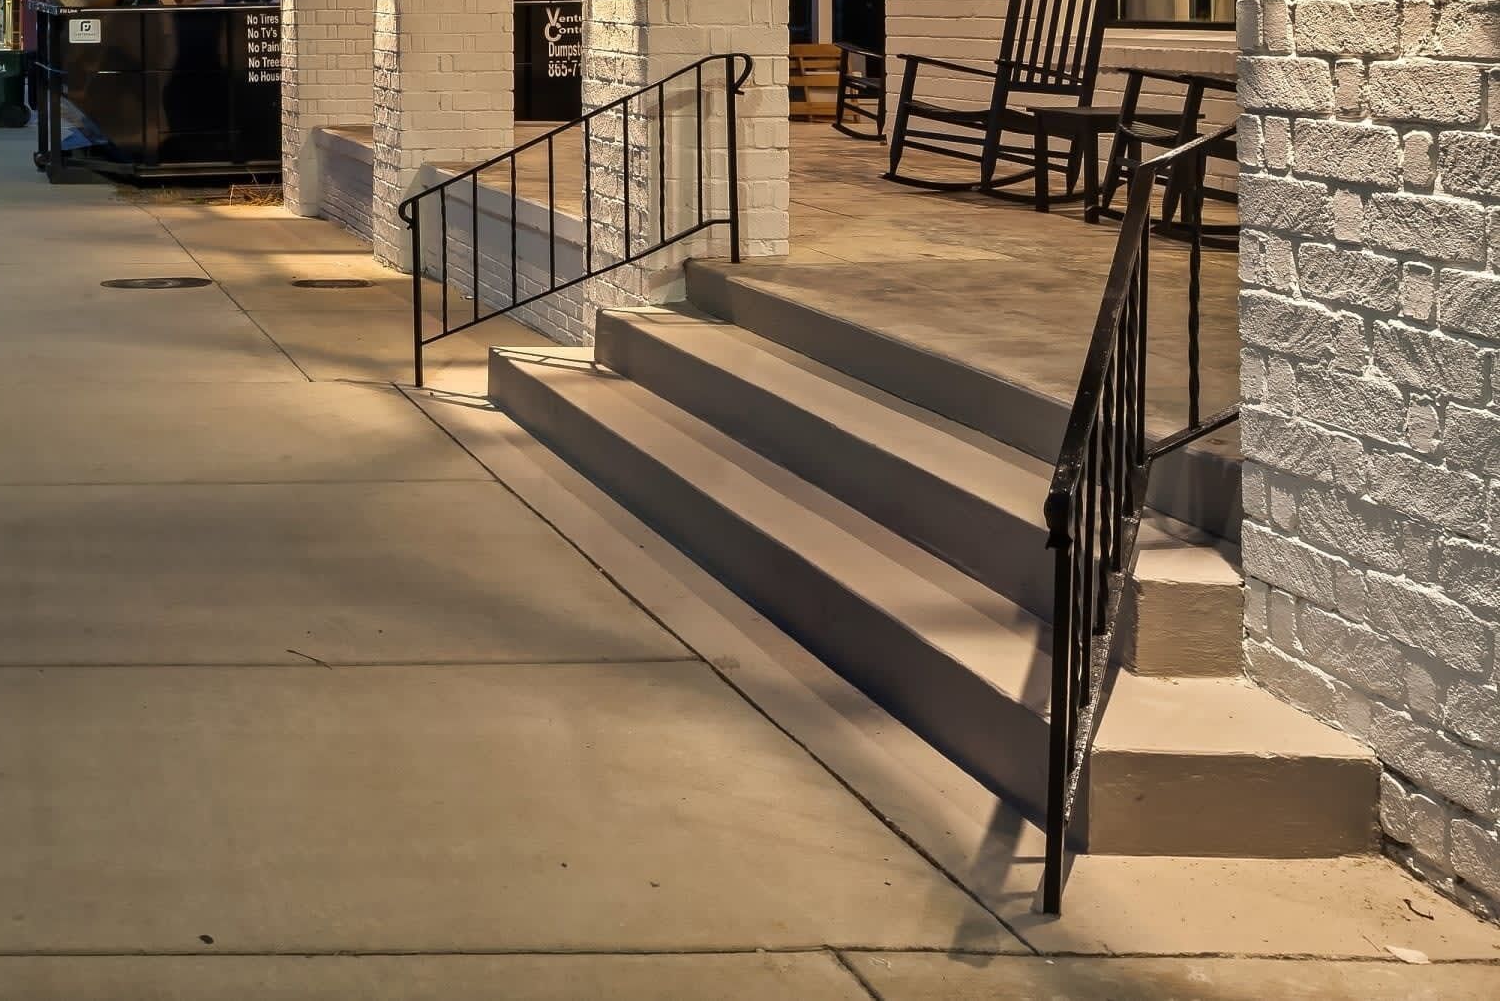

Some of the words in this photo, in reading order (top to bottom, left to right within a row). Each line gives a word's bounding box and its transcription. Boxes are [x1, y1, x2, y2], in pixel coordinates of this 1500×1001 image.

[246, 13, 258, 25] No
[260, 13, 279, 25] Tires
[247, 27, 259, 39] No
[261, 27, 278, 38] Tv's
[248, 42, 260, 53] No
[261, 41, 281, 53] Pain
[548, 40, 582, 61] Dumpst
[248, 57, 260, 68] No
[262, 56, 281, 68] Tree
[248, 71, 259, 82] No
[260, 71, 281, 82] Hous
